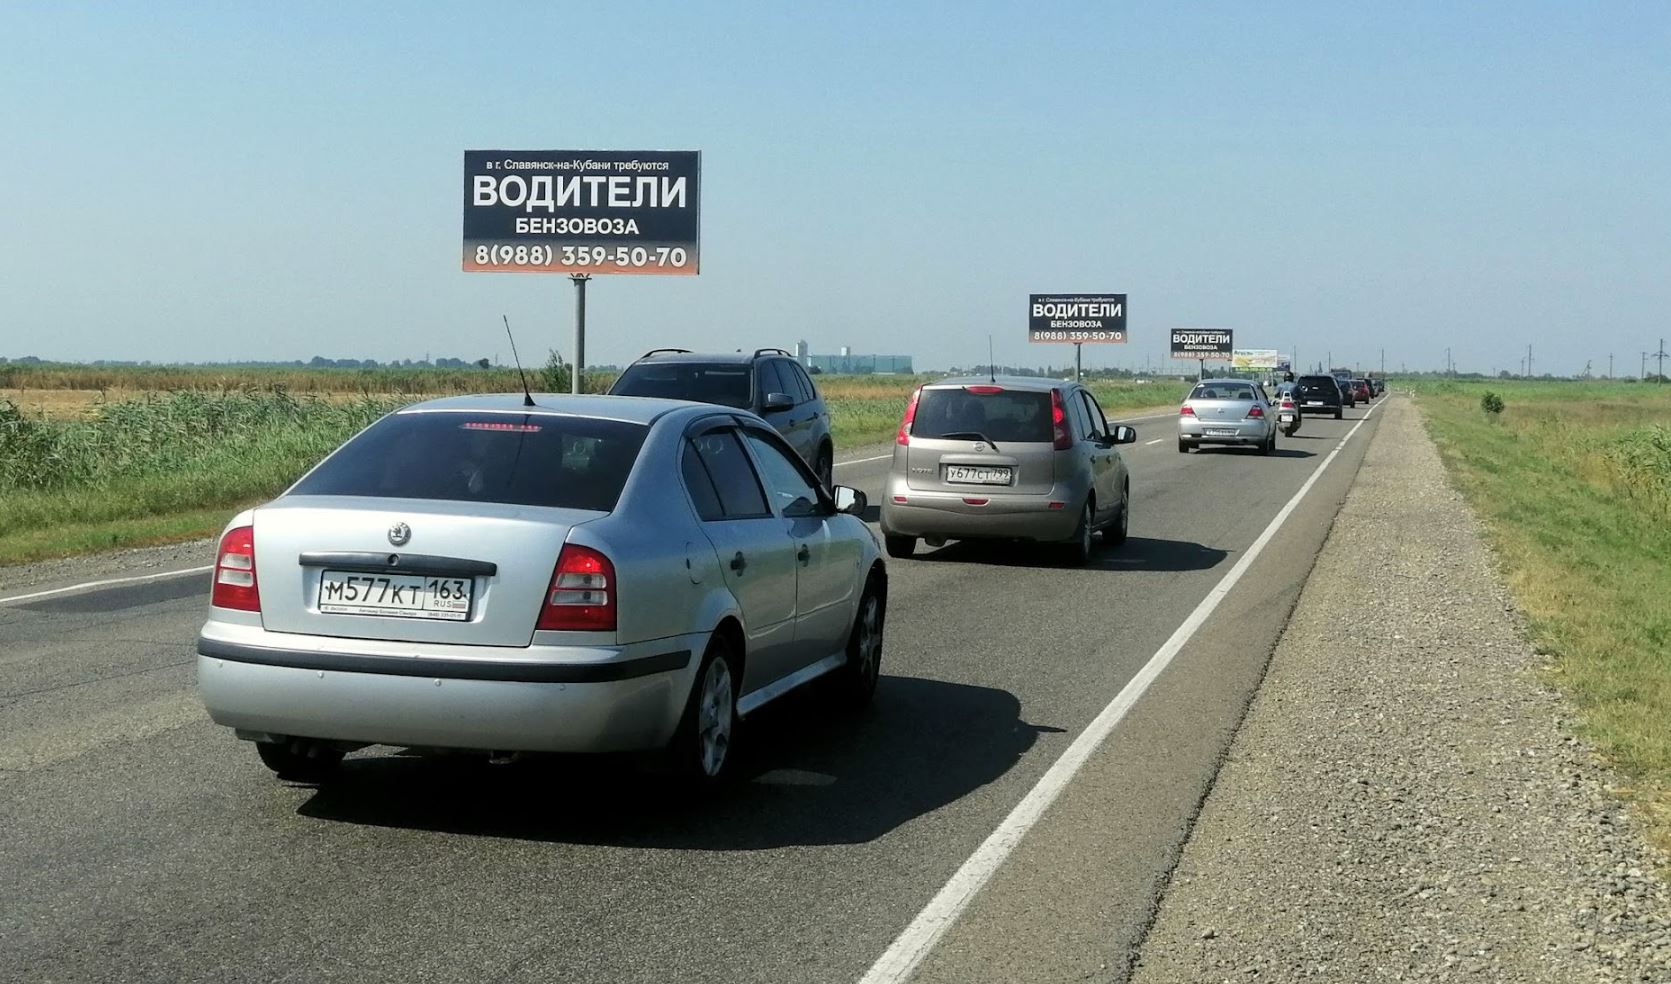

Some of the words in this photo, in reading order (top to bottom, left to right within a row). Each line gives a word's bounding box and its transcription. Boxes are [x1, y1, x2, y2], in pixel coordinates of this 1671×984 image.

[486, 161, 493, 170] в
[504, 159, 611, 171] Славянск-на-Кубани
[614, 161, 669, 172] требуются
[473, 175, 686, 212] ВОДИТЕЛИ
[515, 218, 639, 234] БЕНЗОВОЗА
[475, 244, 553, 266] 8(988)
[561, 246, 687, 267] 359-50-70
[1032, 303, 1122, 319] ВОДИТЕЛИ
[1050, 320, 1102, 328] БЕНЗОВОЗА
[1034, 331, 1067, 340] 8(988)
[1070, 331, 1122, 340] 359-50-70
[1172, 334, 1230, 344] ВОДИТЕЛИ
[428, 579, 464, 600] 163
[433, 600, 452, 608] RUS
